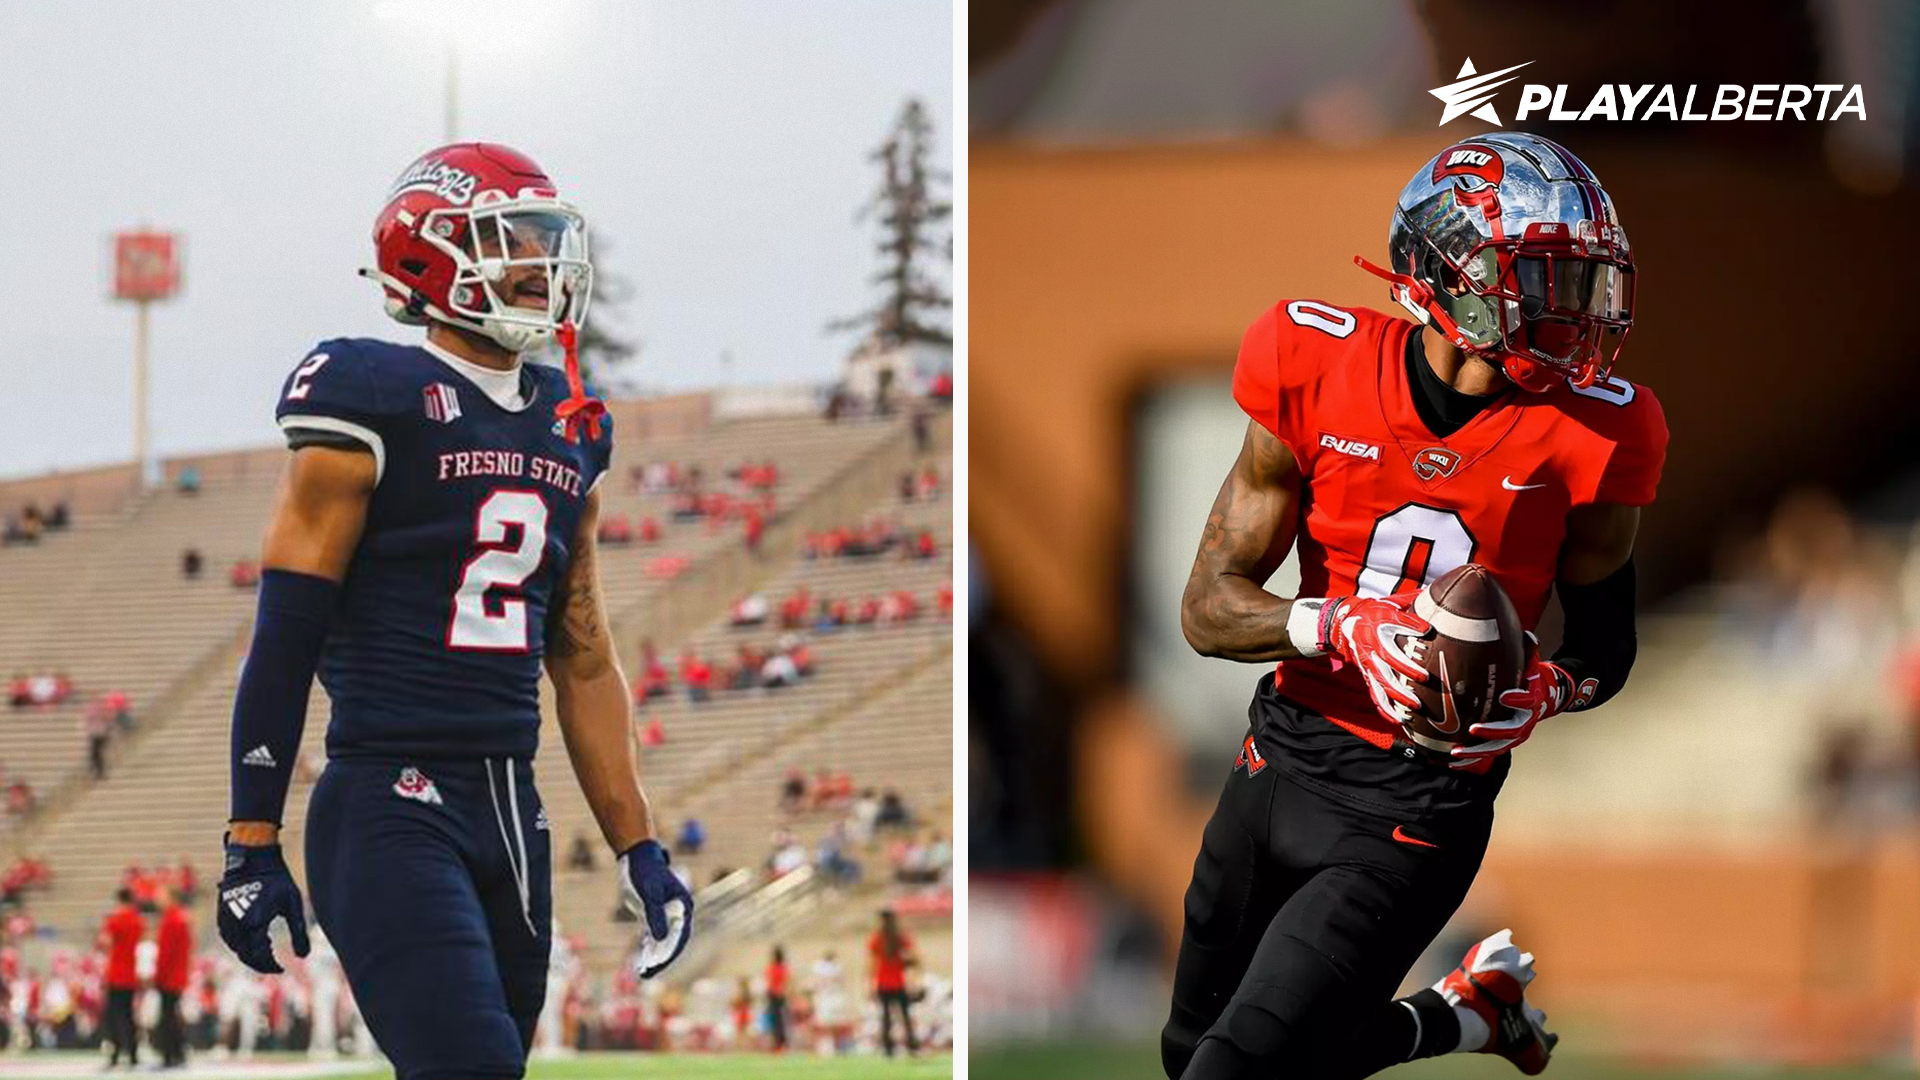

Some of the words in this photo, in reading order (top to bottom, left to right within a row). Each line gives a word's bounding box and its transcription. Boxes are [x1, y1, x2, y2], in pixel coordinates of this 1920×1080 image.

[1446, 150, 1493, 166] WKU
[1539, 224, 1559, 234] NIKE
[287, 352, 330, 401] 2
[438, 451, 524, 480] FRESNO
[446, 488, 549, 655] 2
[1403, 747, 1415, 758] S
